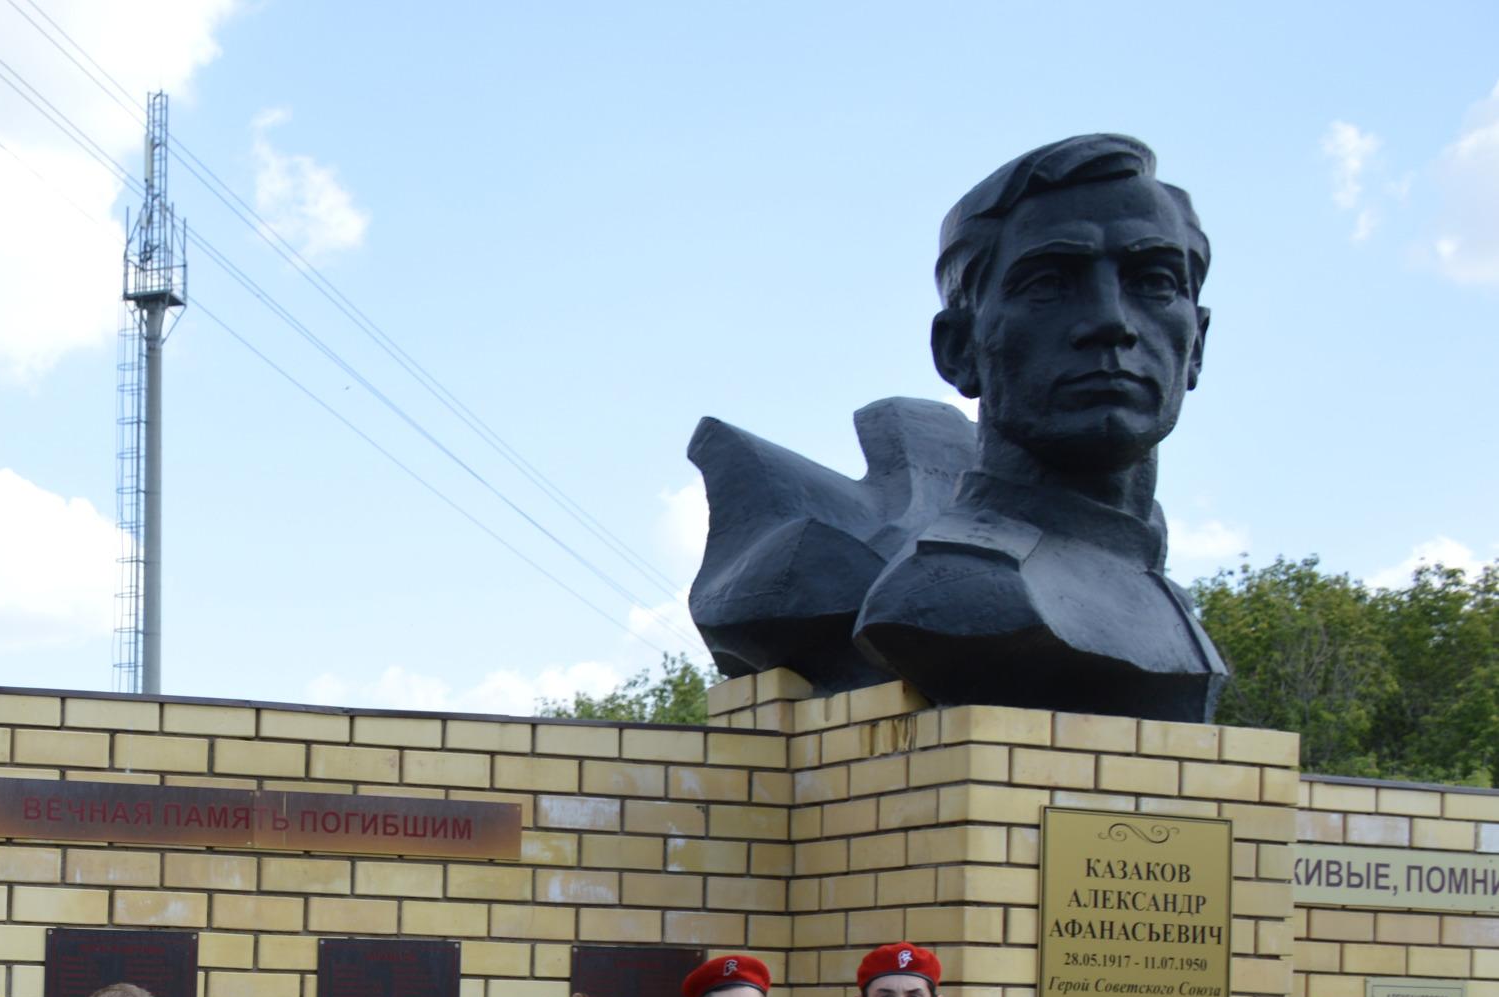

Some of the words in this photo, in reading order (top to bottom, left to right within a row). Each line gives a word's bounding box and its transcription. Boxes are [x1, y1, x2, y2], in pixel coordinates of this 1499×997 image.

[23, 797, 151, 826] ВЕЧНАЯ
[162, 803, 291, 832] ПАМЯТЬ
[300, 809, 472, 841] ПОГИБШИМ
[1084, 857, 1191, 884] КАЗАКОВ
[1067, 888, 1207, 917] АЛЕКСАНДР
[1049, 917, 1223, 946] АФАНАСЬЕВИЧ
[1063, 952, 1130, 969] 28.05.1917
[1143, 956, 1208, 972] 11.07.1950
[1048, 976, 1090, 995] Герой
[1094, 978, 1174, 996] Советского
[1178, 981, 1221, 997] Союза
